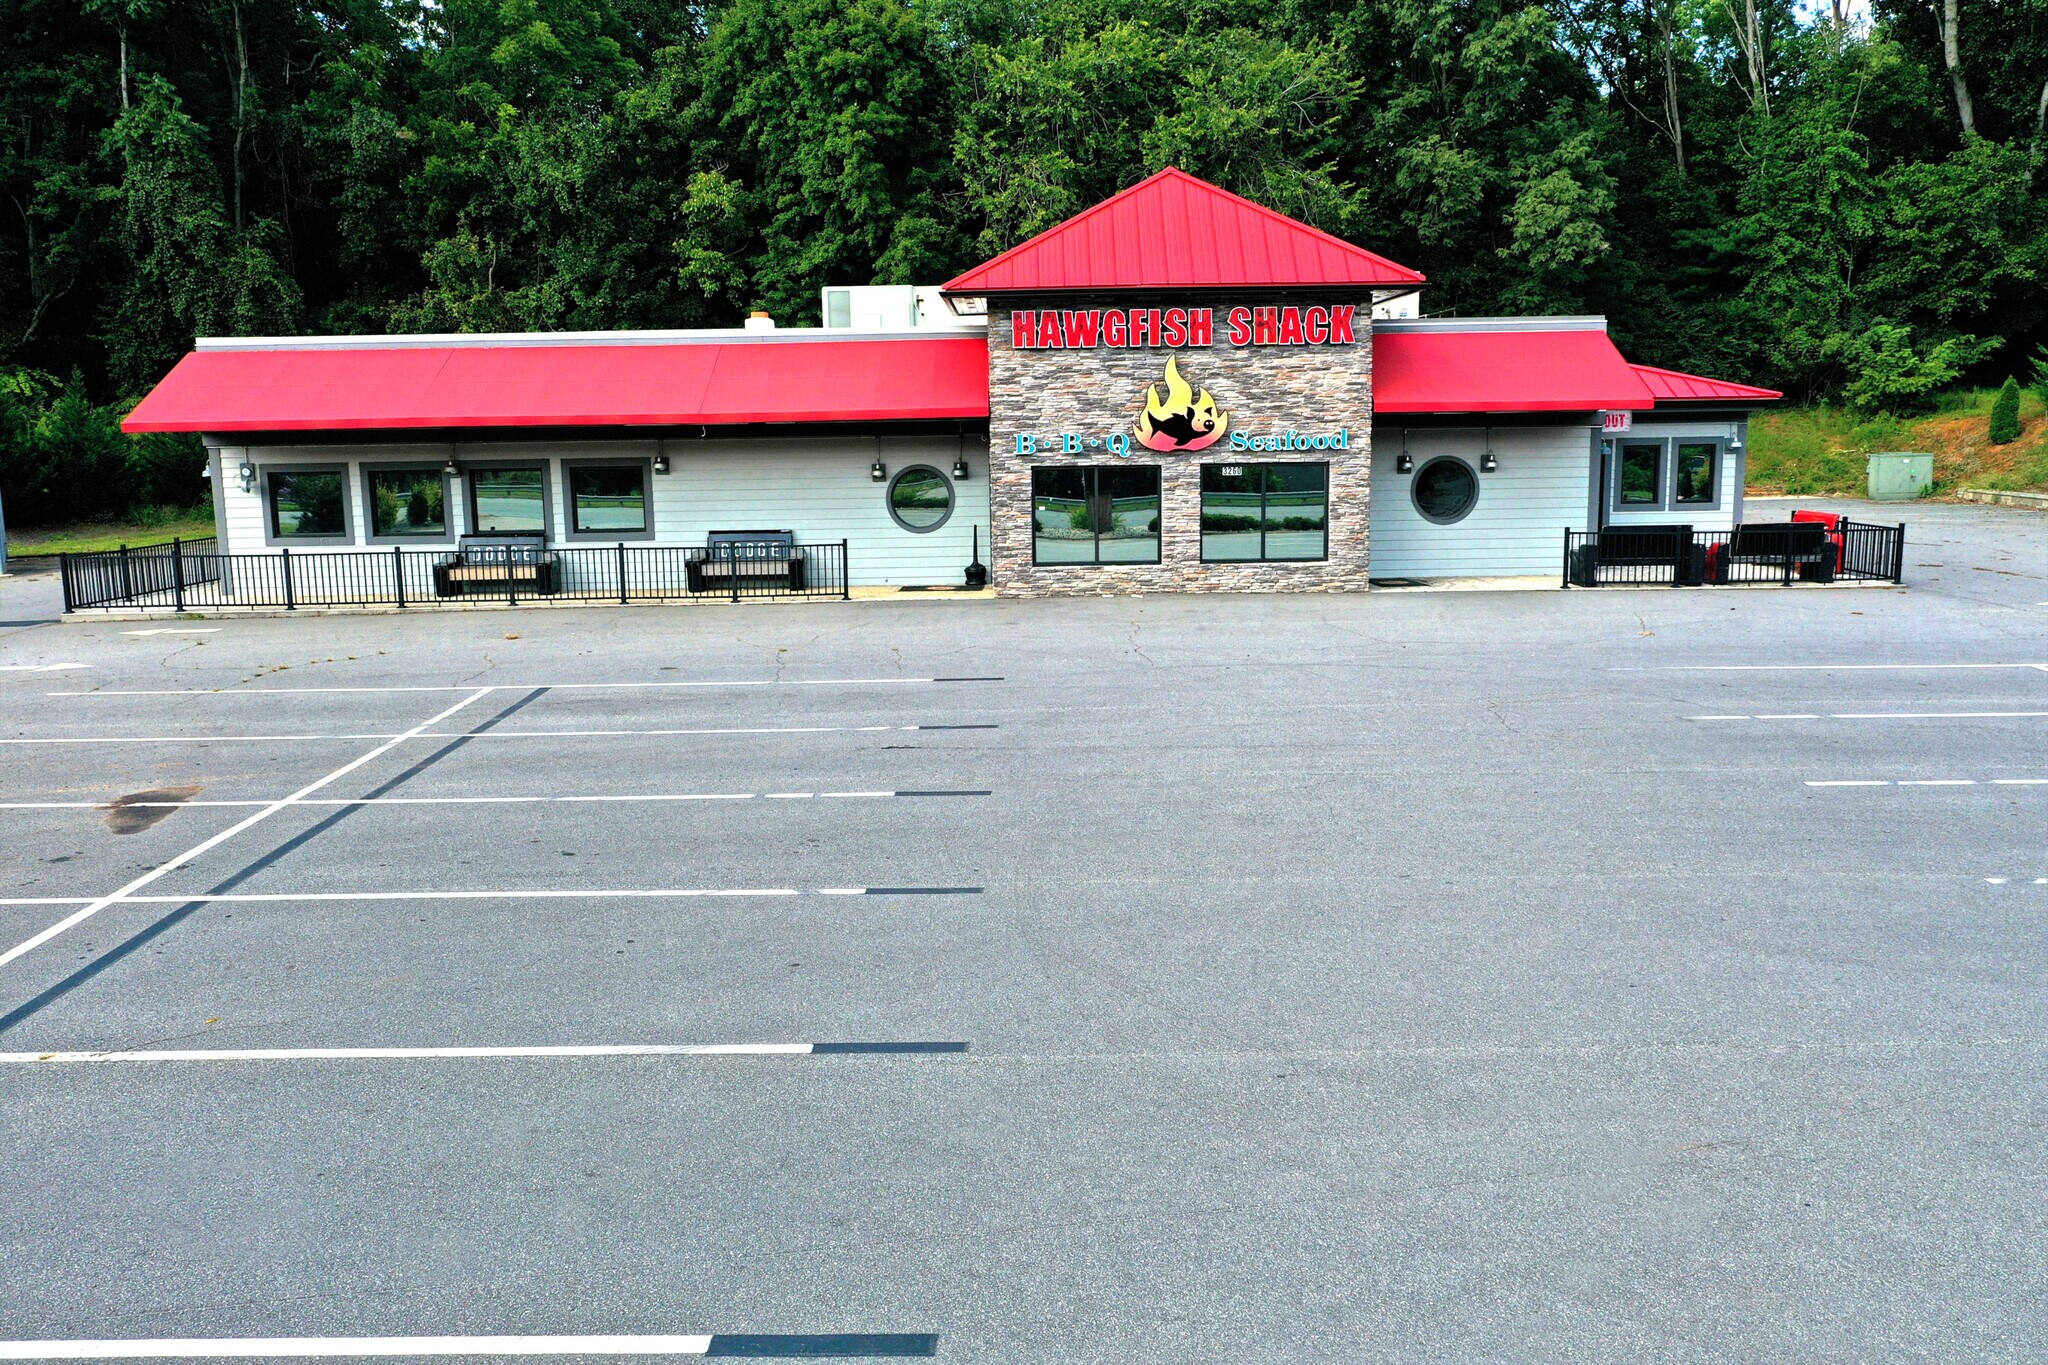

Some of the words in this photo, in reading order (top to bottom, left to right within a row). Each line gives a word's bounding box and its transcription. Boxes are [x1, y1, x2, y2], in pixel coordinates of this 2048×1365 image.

[1011, 307, 1214, 349] HAWGFISH
[1227, 305, 1356, 346] SHACK
[1604, 413, 1626, 428] OUT
[1229, 428, 1350, 451] Seafood
[473, 546, 531, 561] DODGE
[721, 542, 779, 557] DODGE
